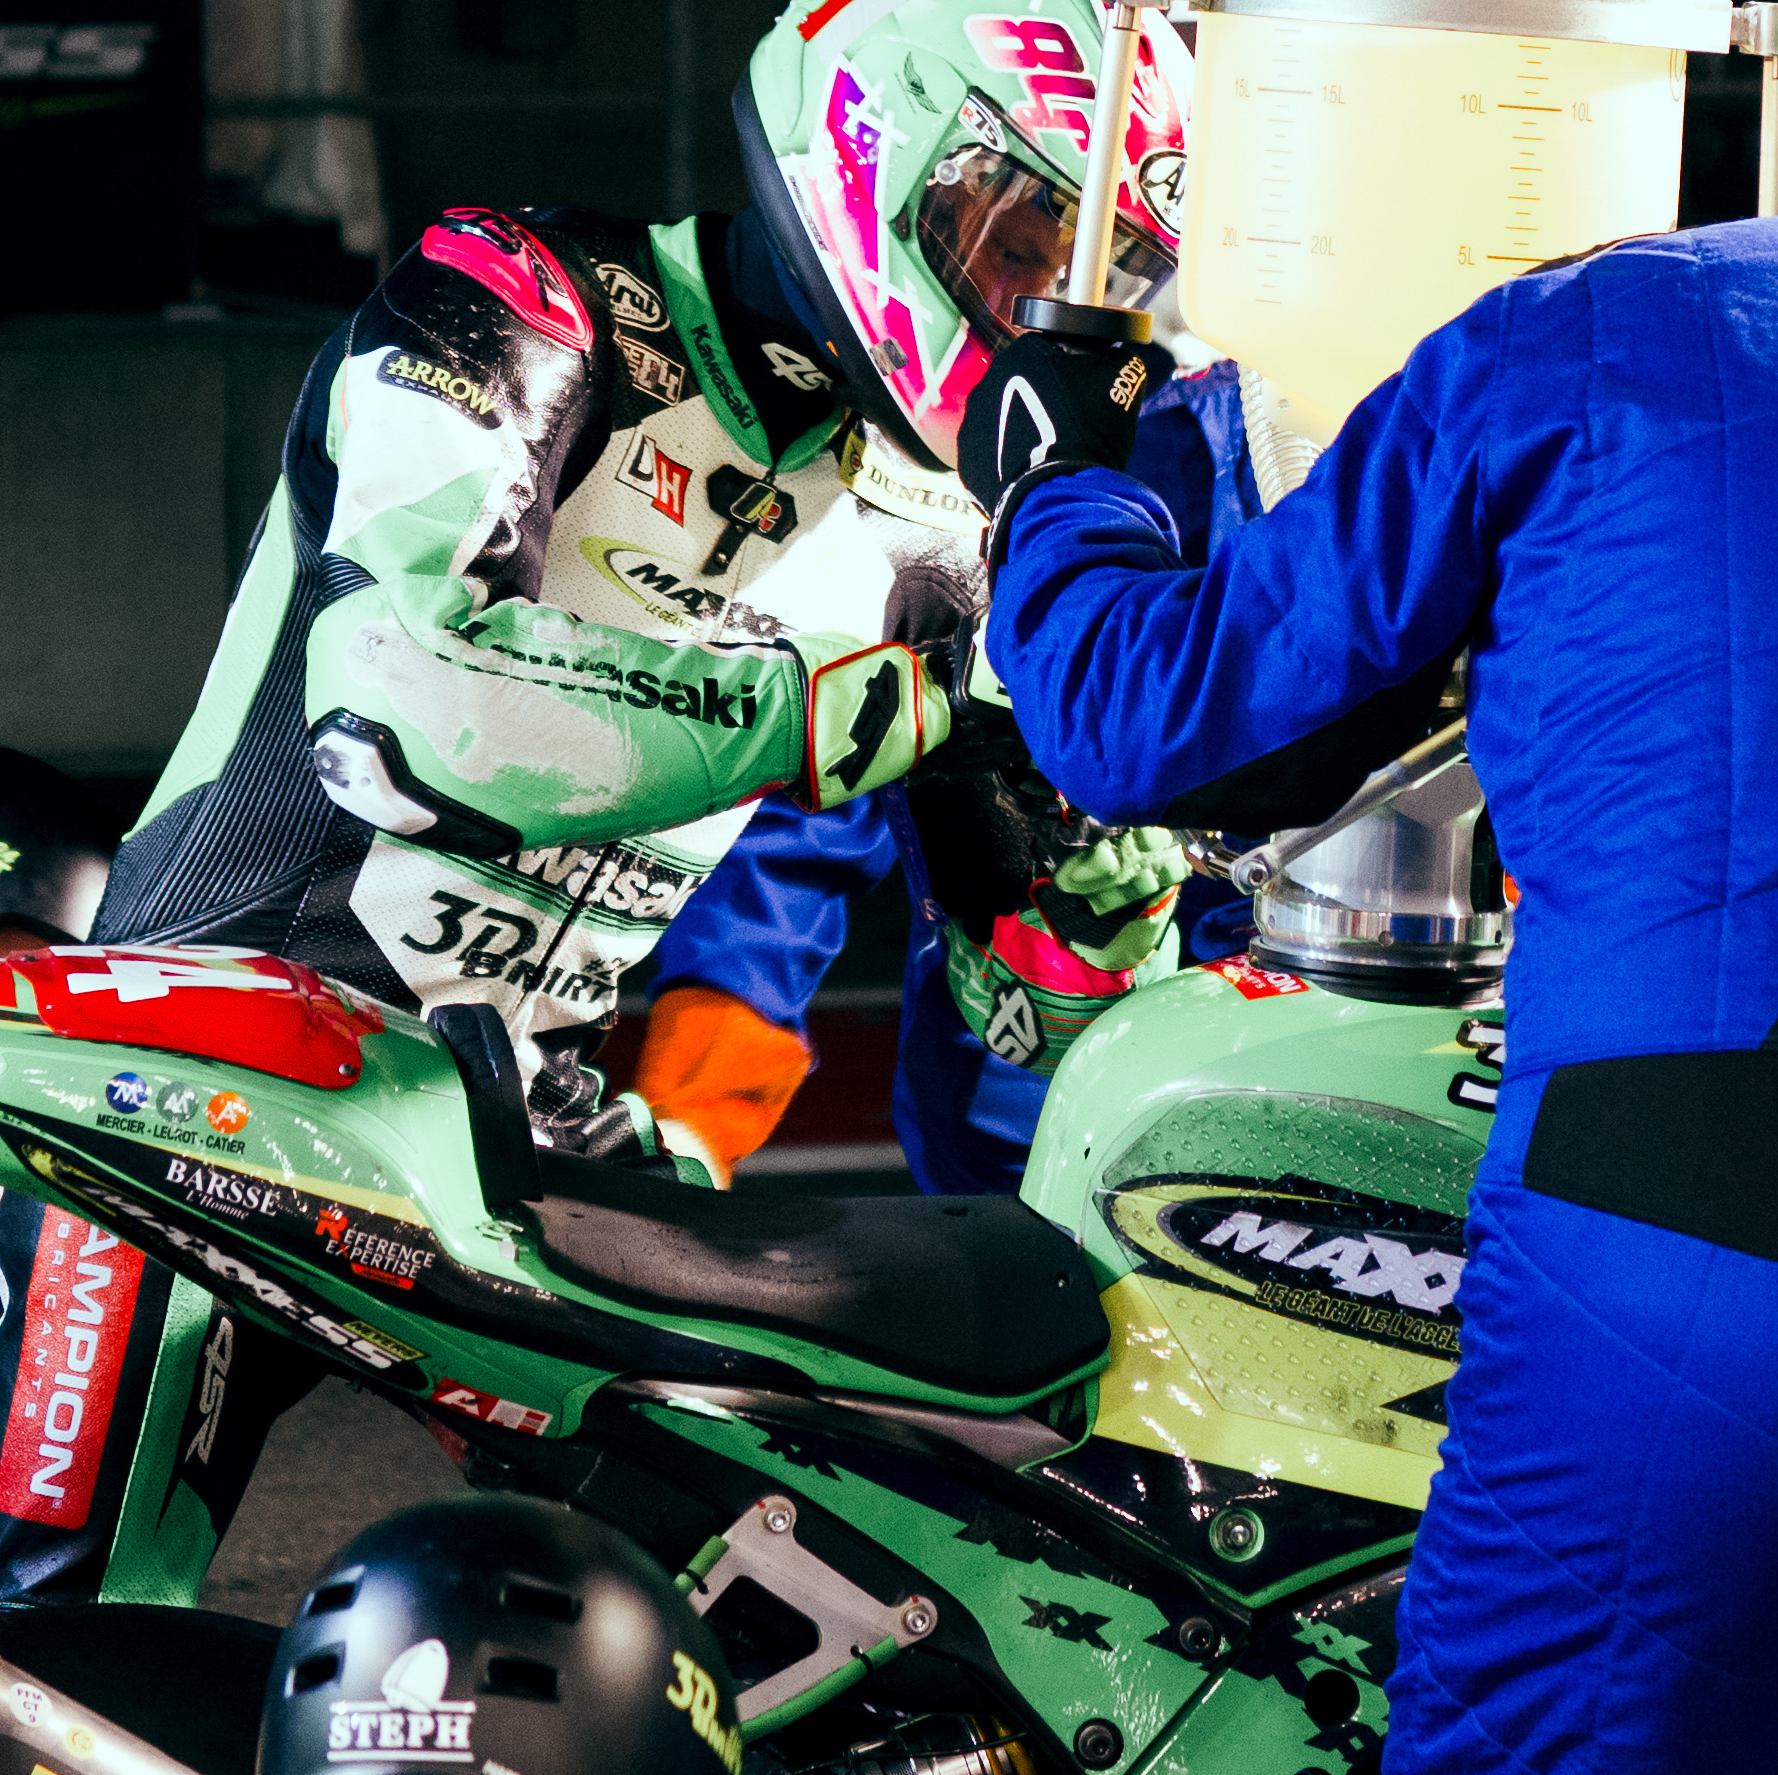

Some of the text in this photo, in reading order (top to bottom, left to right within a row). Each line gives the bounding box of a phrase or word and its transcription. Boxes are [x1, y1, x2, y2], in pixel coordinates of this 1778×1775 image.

[1322, 85, 1345, 105] 15L
[1460, 94, 1486, 114] 10L
[1572, 102, 1592, 122] 10L
[1312, 235, 1335, 255] 20L
[1458, 246, 1476, 266] 5L
[386, 355, 496, 415] ARROW
[690, 323, 759, 429] Kawasaki
[401, 890, 539, 962] 3D
[96, 1113, 146, 1135] MERCIER
[206, 1134, 246, 1155] CATIER
[166, 1158, 278, 1217] BARSSE
[185, 1189, 251, 1221] L'Homme
[325, 1239, 421, 1279] EXPERTISE
[1256, 1280, 1289, 1307] LE
[24, 1223, 71, 1419] BRICANTS
[29, 1223, 119, 1500] AMPION
[328, 1712, 473, 1750] STEPH
